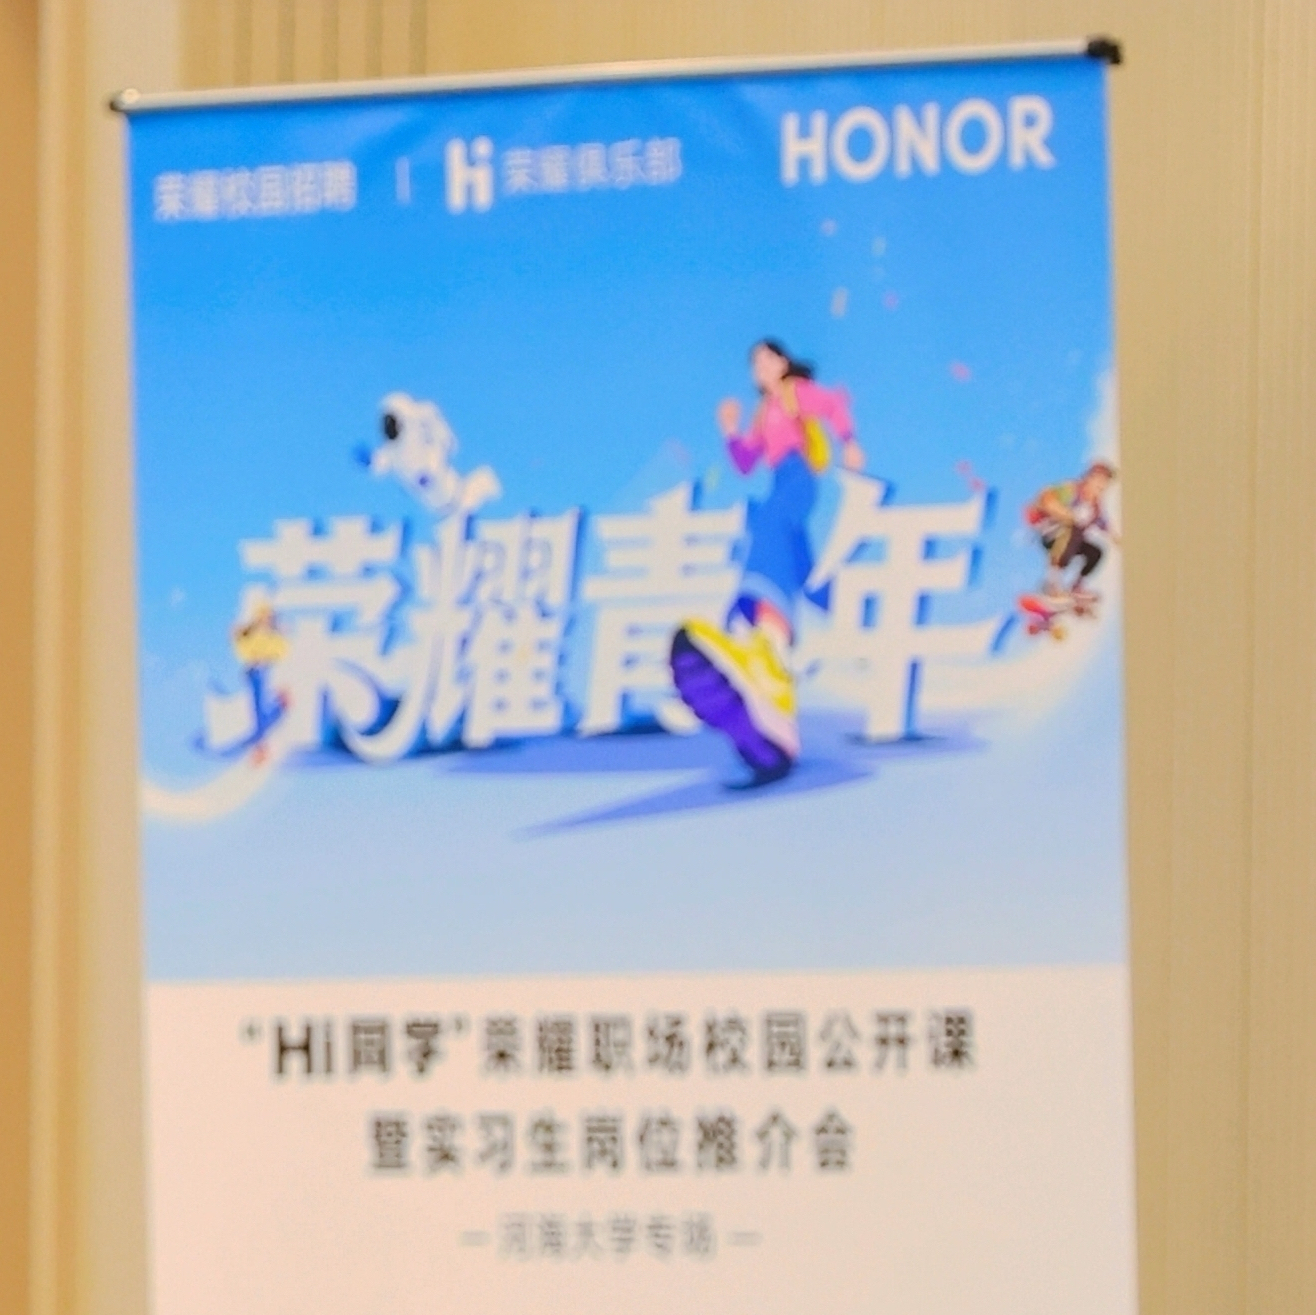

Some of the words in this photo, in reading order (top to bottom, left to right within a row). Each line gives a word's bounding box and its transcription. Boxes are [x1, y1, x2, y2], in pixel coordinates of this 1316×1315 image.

[503, 138, 682, 193] 荣耀俱乐部
[780, 95, 1055, 185] HONOR
[204, 480, 998, 745] 荣耀青年
[371, 1110, 852, 1173] 暨实习生岗位推介会
